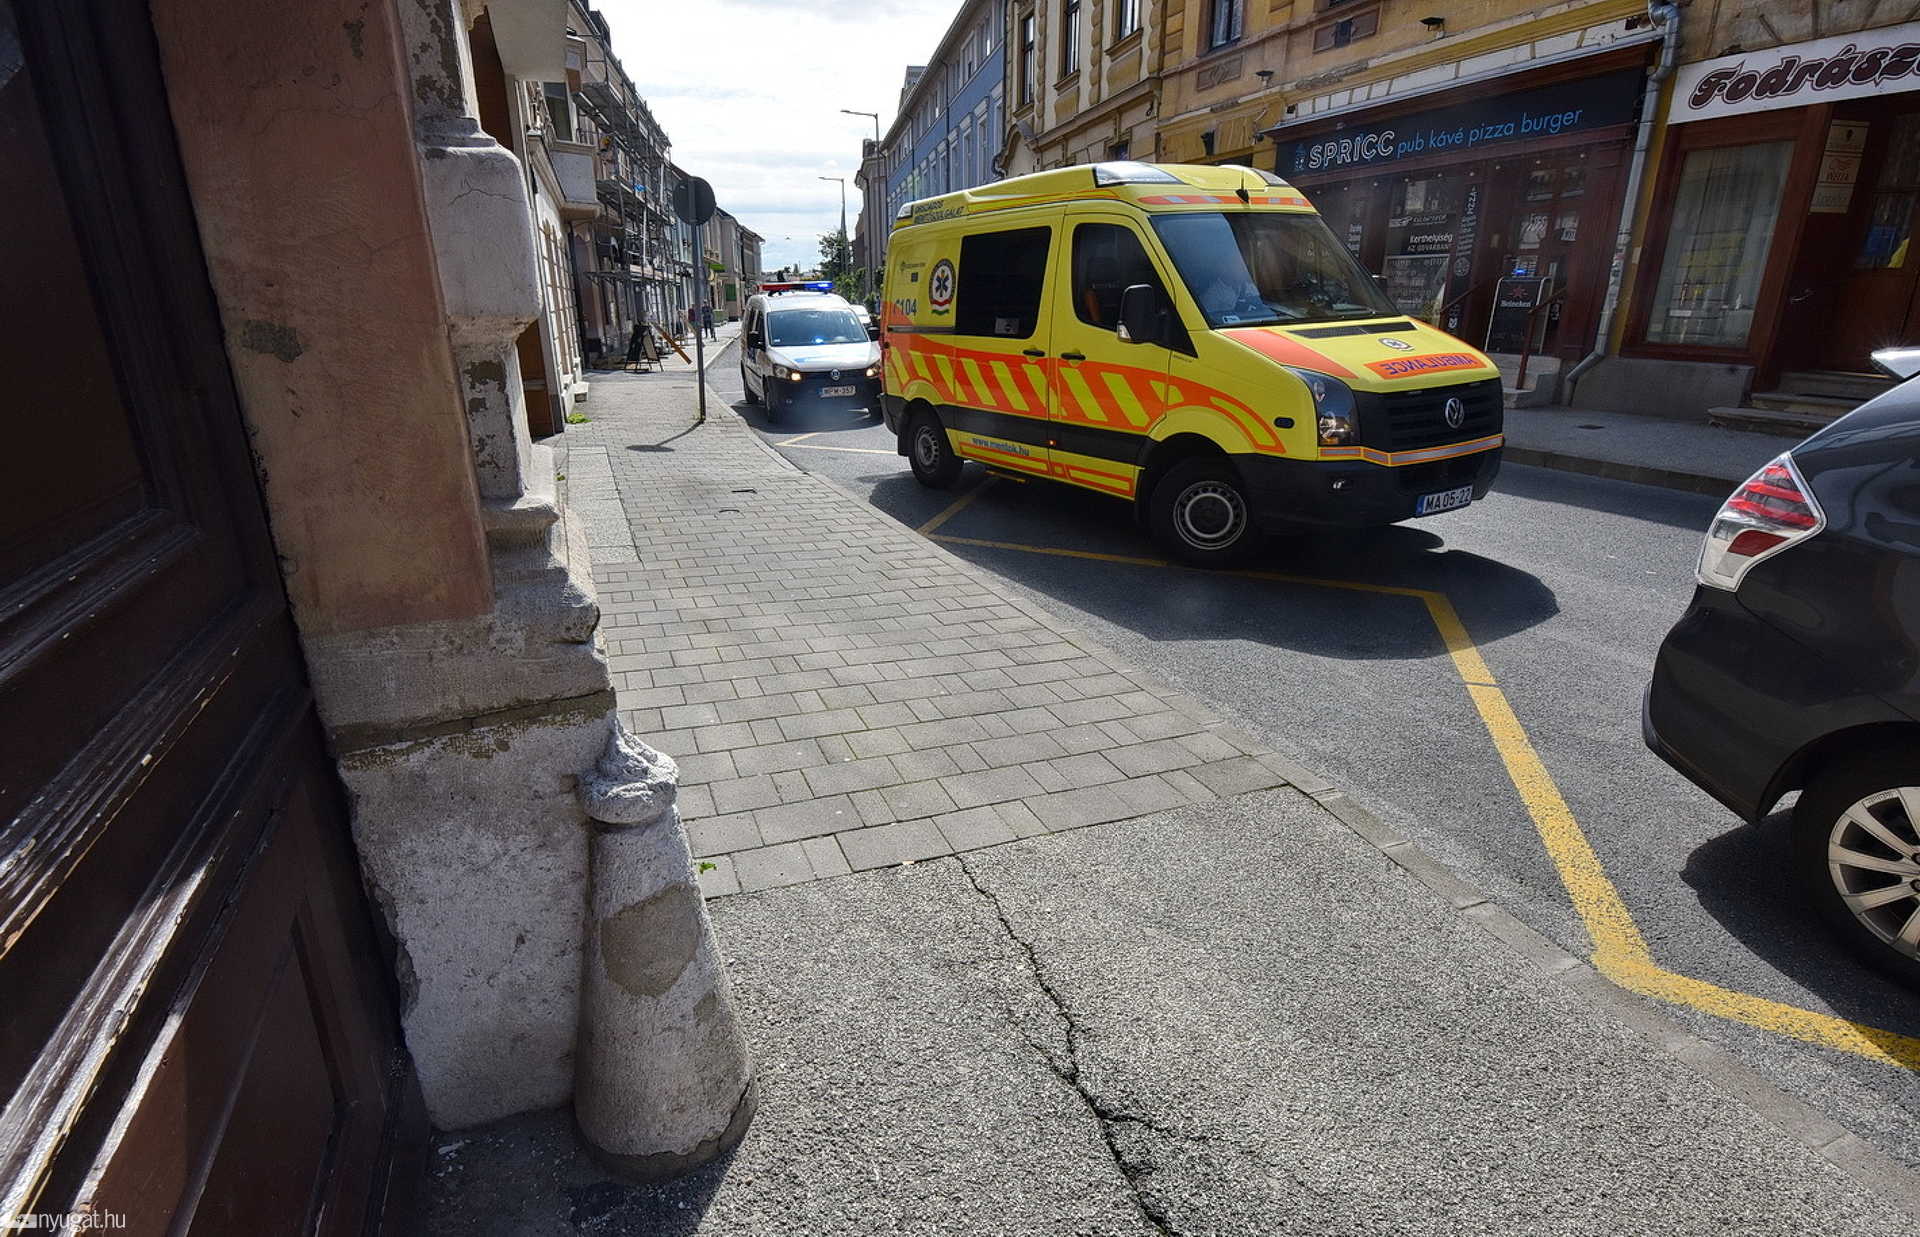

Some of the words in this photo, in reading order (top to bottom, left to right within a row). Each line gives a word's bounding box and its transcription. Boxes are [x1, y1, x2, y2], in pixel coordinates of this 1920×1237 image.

[1689, 44, 1920, 112] Fodrász
[1396, 136, 1425, 158] pub
[1428, 127, 1464, 150] kávé
[1467, 122, 1515, 147] pizza
[1520, 108, 1583, 134] burger
